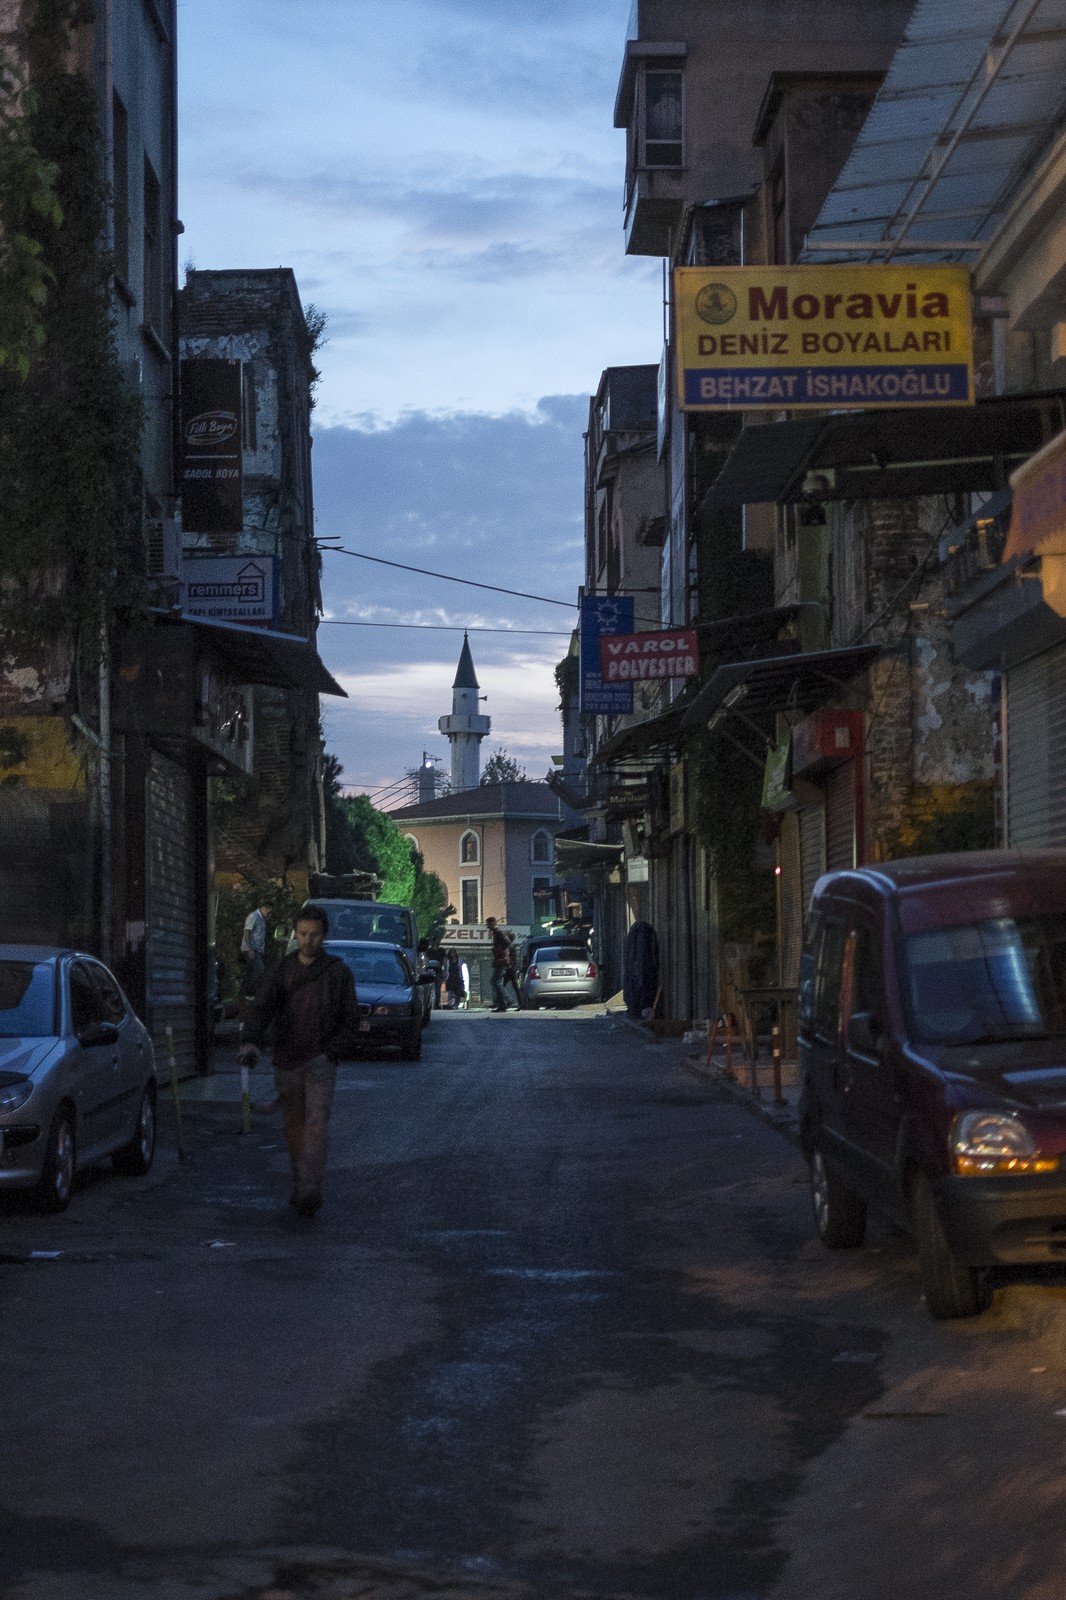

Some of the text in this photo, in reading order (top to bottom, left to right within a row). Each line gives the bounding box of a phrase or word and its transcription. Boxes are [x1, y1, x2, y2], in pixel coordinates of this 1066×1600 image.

[748, 282, 950, 321] Moravia
[698, 328, 951, 356] DENİZ BOYALARI
[700, 368, 951, 399] BEHZAT İSHAKOĞLU
[215, 468, 239, 478] BOYA
[190, 585, 257, 596] remmers
[608, 638, 689, 655] VAROL
[608, 655, 695, 680] POLYESTER
